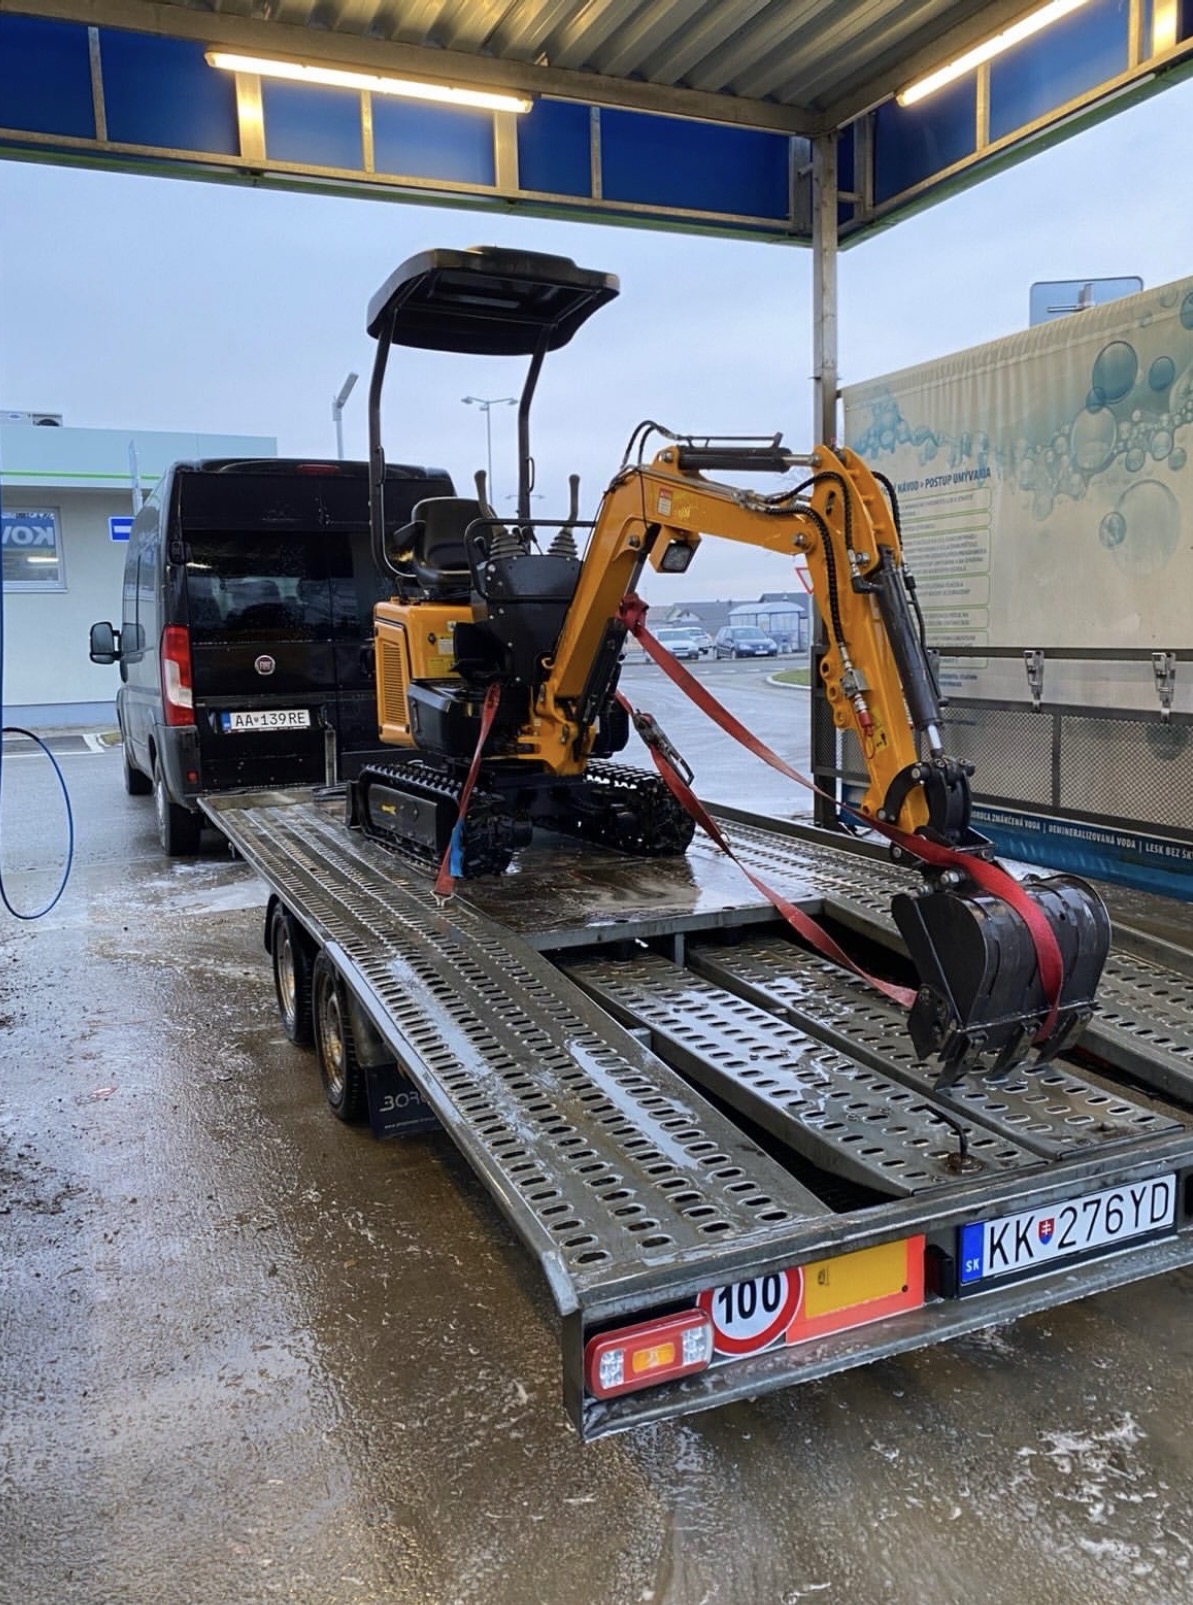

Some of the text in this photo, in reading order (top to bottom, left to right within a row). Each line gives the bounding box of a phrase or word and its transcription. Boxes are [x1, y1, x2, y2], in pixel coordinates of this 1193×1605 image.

[925, 474, 952, 489] POSTUP
[236, 714, 254, 727] AA
[260, 712, 306, 726] 139RE
[1024, 819, 1041, 831] VODA
[1048, 824, 1115, 844] DEMINERALIZOVANÁ
[1116, 836, 1136, 850] VODA
[1145, 842, 1163, 855] LESK
[1165, 845, 1180, 858] BEZ
[988, 1182, 1170, 1270] KK 276YD
[965, 1257, 980, 1273] SK
[718, 1273, 781, 1324] 100
